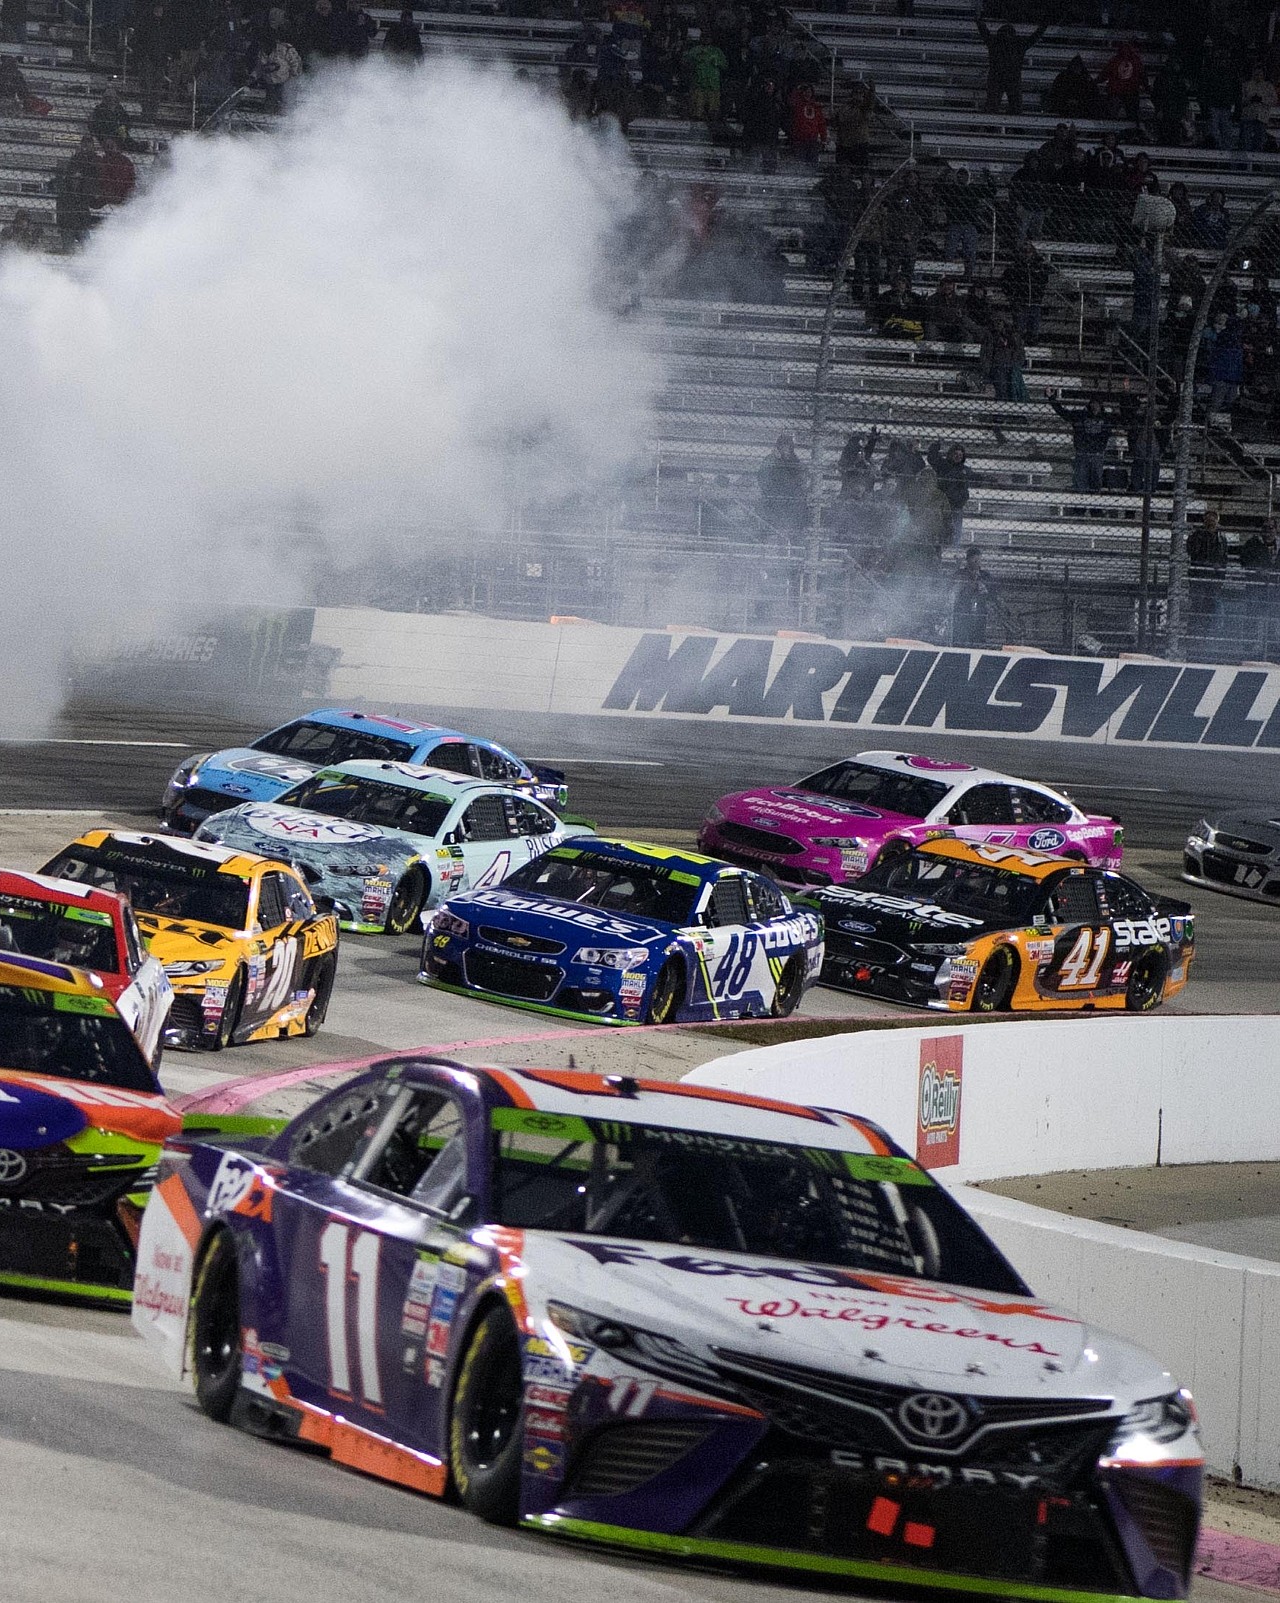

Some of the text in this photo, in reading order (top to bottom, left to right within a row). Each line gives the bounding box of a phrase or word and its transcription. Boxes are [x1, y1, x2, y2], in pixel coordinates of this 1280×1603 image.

[242, 807, 387, 842] BUSCH
[743, 797, 848, 824] EcoBoost
[272, 821, 319, 838] NA
[1034, 832, 1059, 849] Ford
[123, 855, 188, 873] MONSTER
[473, 850, 511, 890] 4
[597, 854, 652, 871] MONSTER
[843, 856, 868, 865] MAHLE
[365, 879, 392, 887] MOOG
[365, 886, 392, 895] MAHLE
[815, 885, 985, 929] state
[820, 895, 950, 929] WATER HEATERS
[843, 920, 869, 932] Ford
[1113, 917, 1171, 946] state
[433, 935, 451, 948] 48
[475, 942, 558, 966] CHEVROLET SS
[713, 933, 758, 998] 48
[824, 954, 886, 974] SION
[951, 965, 977, 973] MAHLE
[1059, 927, 1110, 989] 41
[257, 935, 298, 1012] 20
[623, 980, 646, 988] MAHLE
[921, 1065, 959, 1129] O'Reilly
[644, 1128, 797, 1160] MONSTER
[320, 1221, 384, 1404] 11
[727, 1298, 1060, 1357] Walgreens
[608, 1375, 663, 1418] 11
[831, 1450, 1040, 1490] CAMRY
